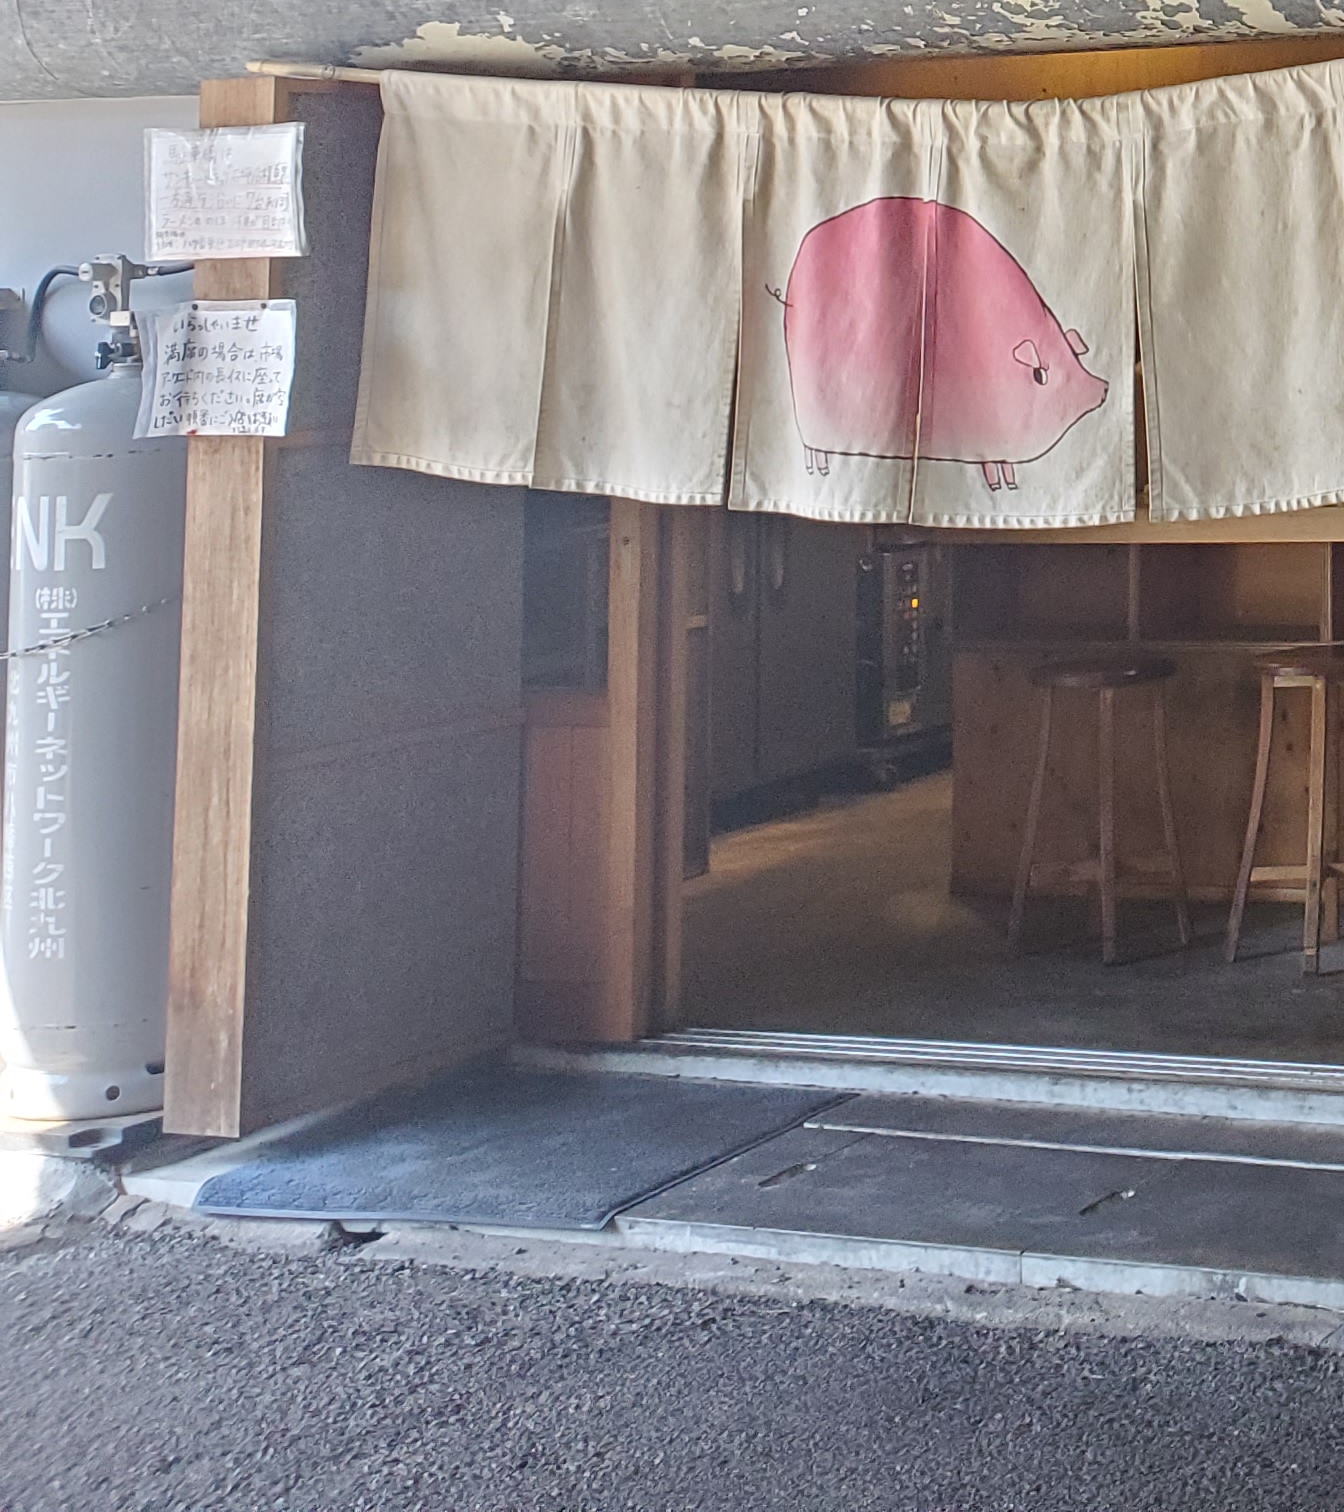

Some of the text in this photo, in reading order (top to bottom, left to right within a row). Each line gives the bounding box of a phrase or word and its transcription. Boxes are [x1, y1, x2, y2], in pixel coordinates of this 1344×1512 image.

[173, 313, 259, 333] いらっしゃいませ
[10, 493, 113, 571] NK
